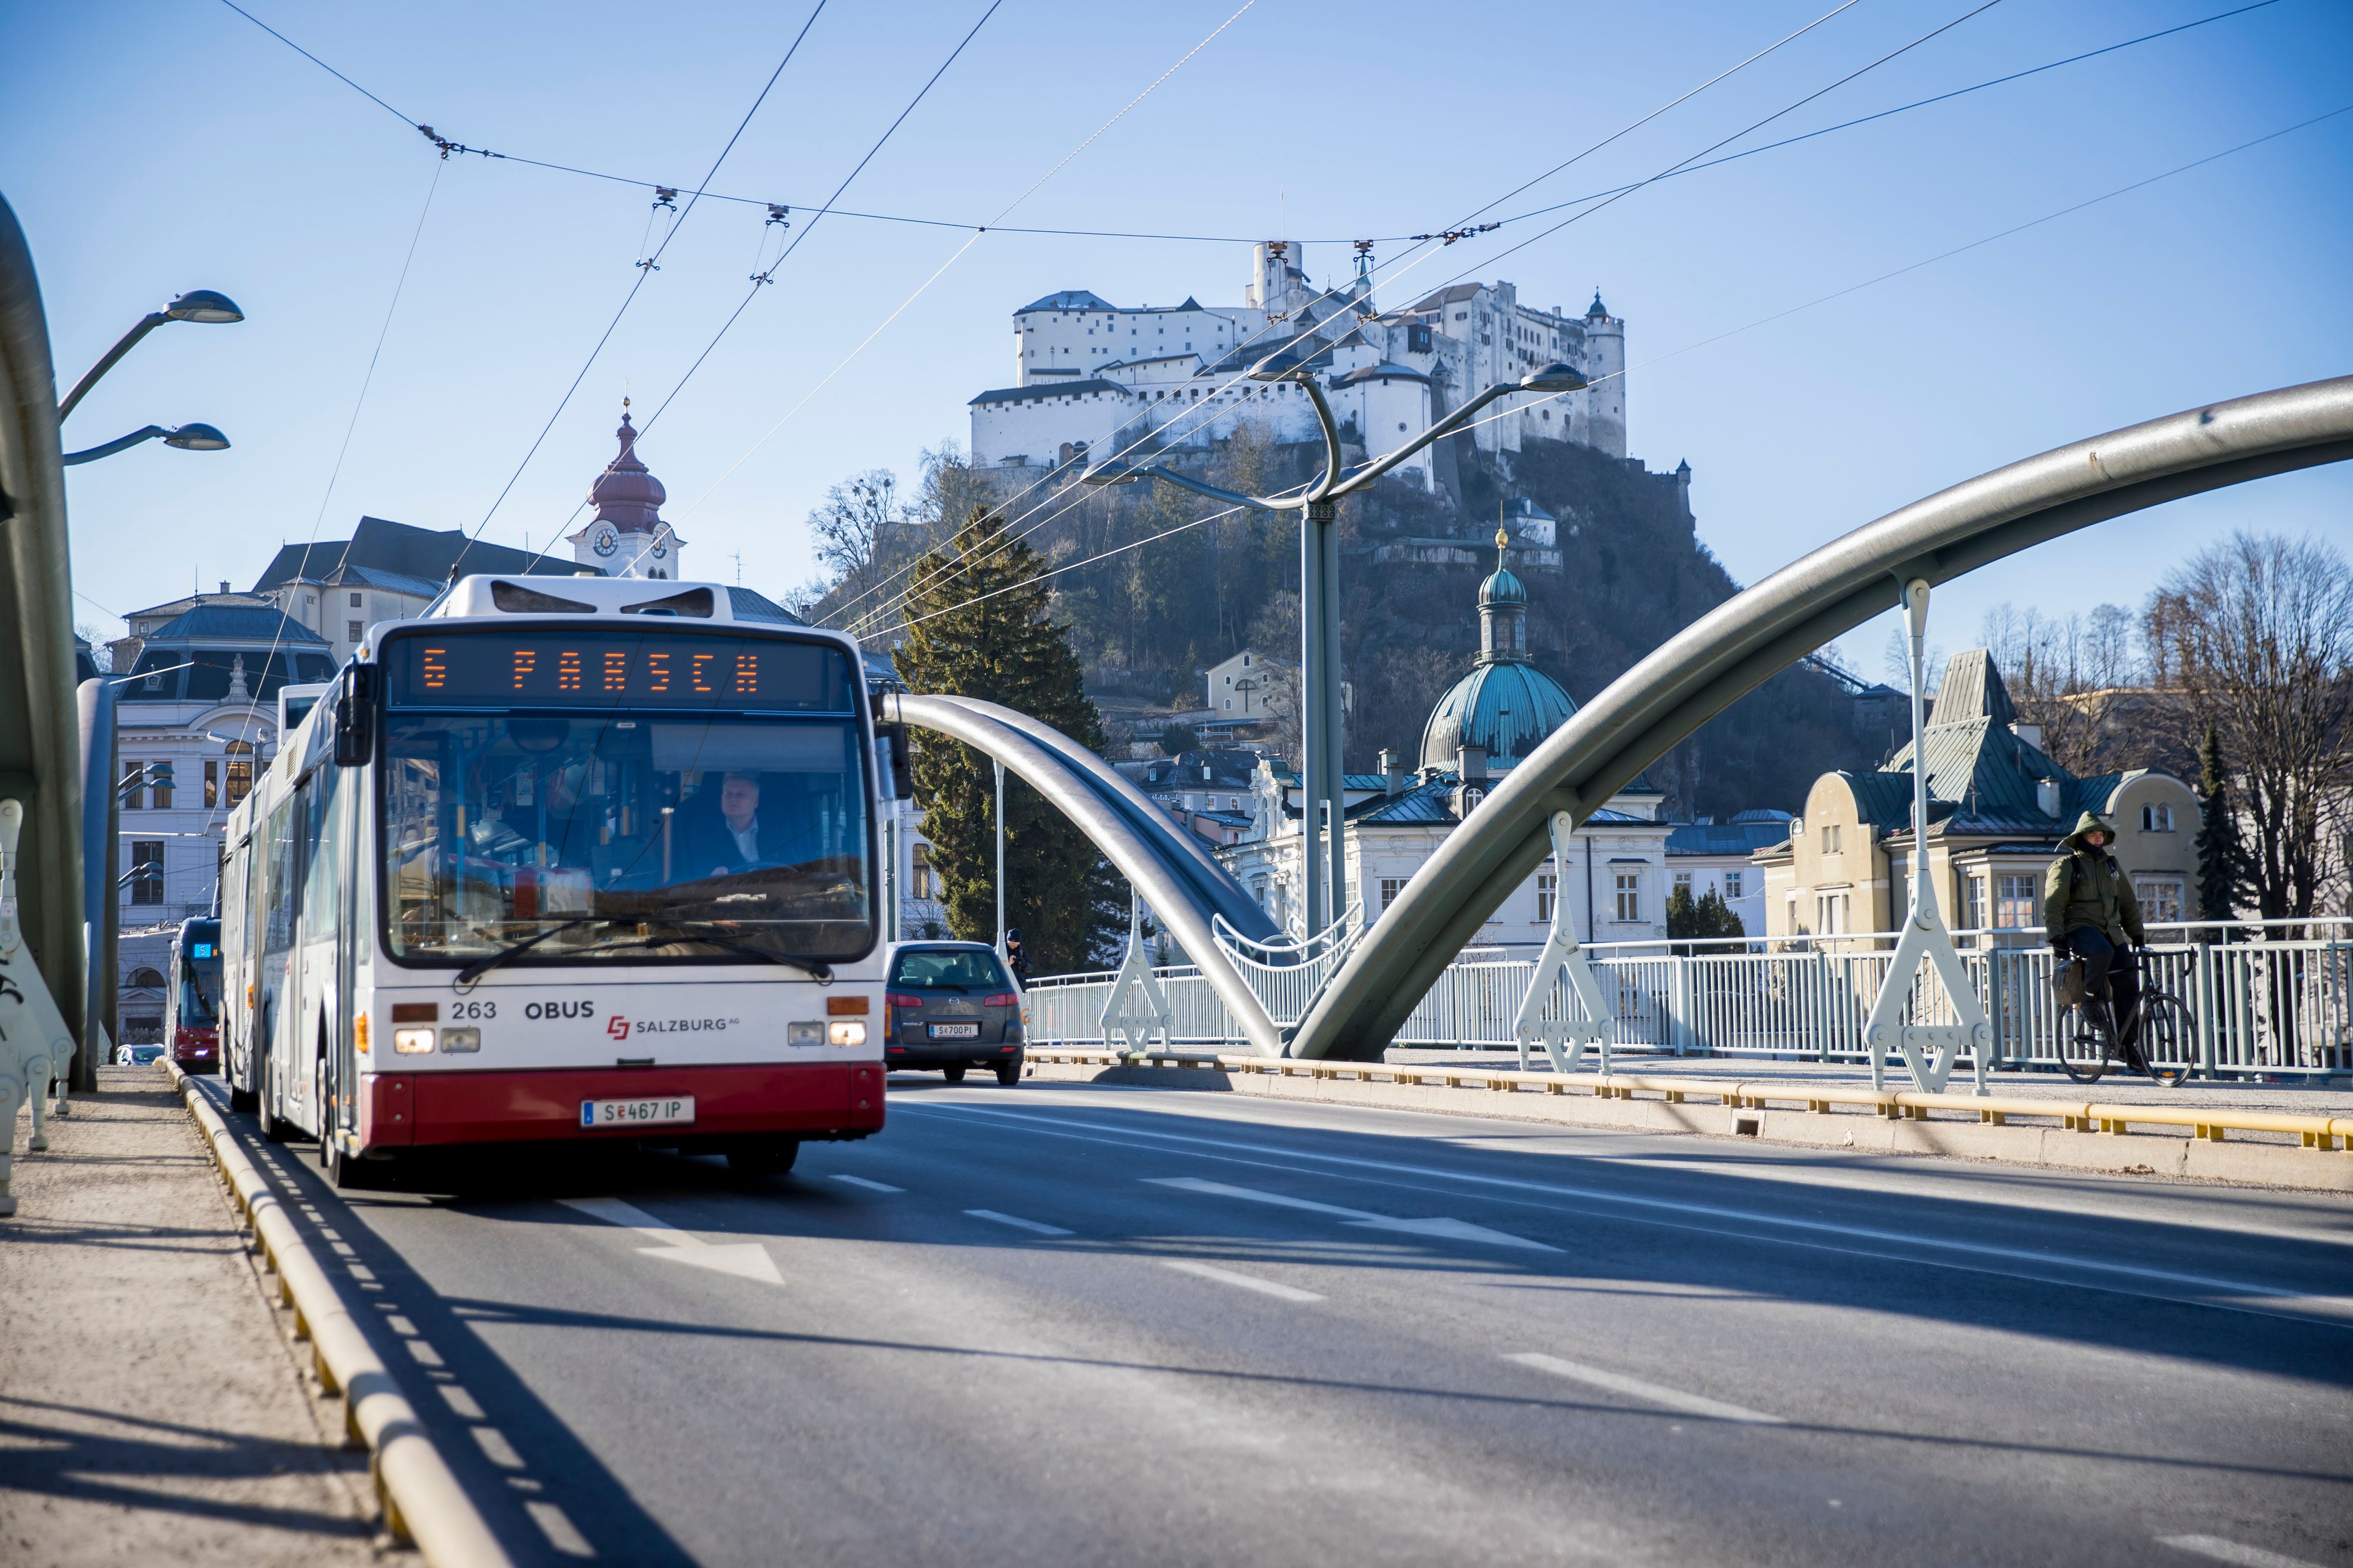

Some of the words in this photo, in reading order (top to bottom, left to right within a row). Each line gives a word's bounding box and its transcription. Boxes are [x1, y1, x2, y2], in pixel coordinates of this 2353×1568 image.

[425, 649, 445, 687] 6
[514, 651, 757, 692] PARSCH
[200, 945, 206, 956] 5
[452, 1001, 497, 1019] 263
[525, 1000, 595, 1020] OBUS
[636, 1018, 726, 1033] SALZBURG
[939, 1026, 944, 1035] S
[605, 1105, 615, 1121] S
[628, 1102, 659, 1119] 467
[665, 1101, 681, 1118] IP
